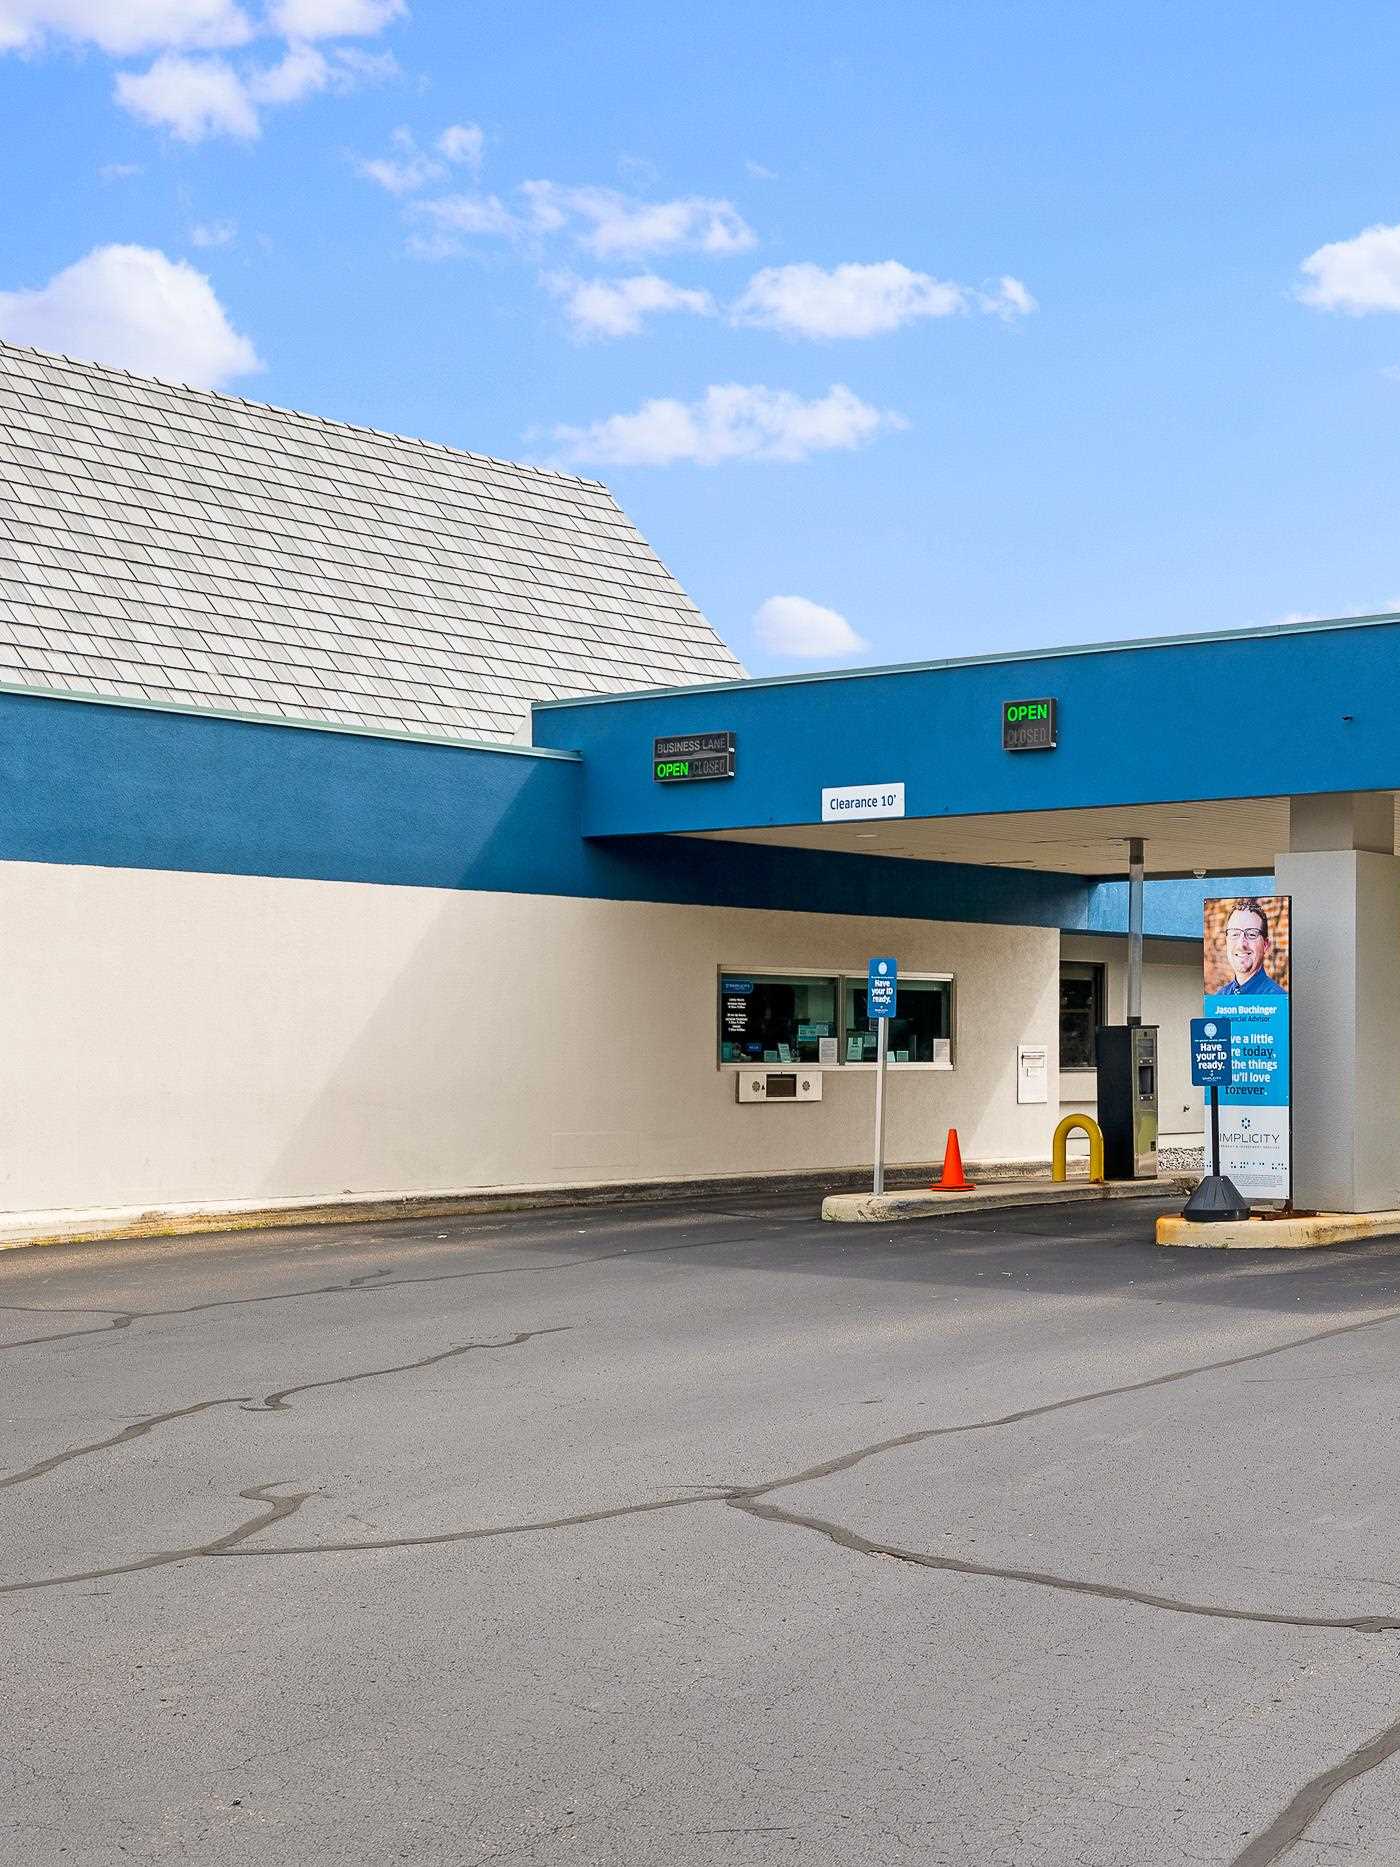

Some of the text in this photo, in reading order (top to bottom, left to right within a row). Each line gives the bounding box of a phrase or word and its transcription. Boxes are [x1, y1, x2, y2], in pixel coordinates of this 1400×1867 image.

[1007, 703, 1048, 722] OPEN
[657, 737, 726, 754] BUSINESS LANE
[657, 759, 725, 778] OPEN CLOSED
[830, 797, 878, 811] Clearance
[874, 979, 891, 988] Have
[871, 987, 894, 997] your ID
[1215, 1005, 1237, 1014] Jason
[1242, 1035, 1249, 1044] a
[1250, 1033, 1274, 1044] little
[1200, 1042, 1223, 1052] Have
[1243, 1046, 1277, 1059] today,
[1195, 1051, 1227, 1062] your ID
[1198, 1060, 1225, 1070] ready.
[1231, 1059, 1278, 1071] the things
[1249, 1072, 1271, 1082] love
[1219, 1133, 1280, 1144] IMPLICITY
